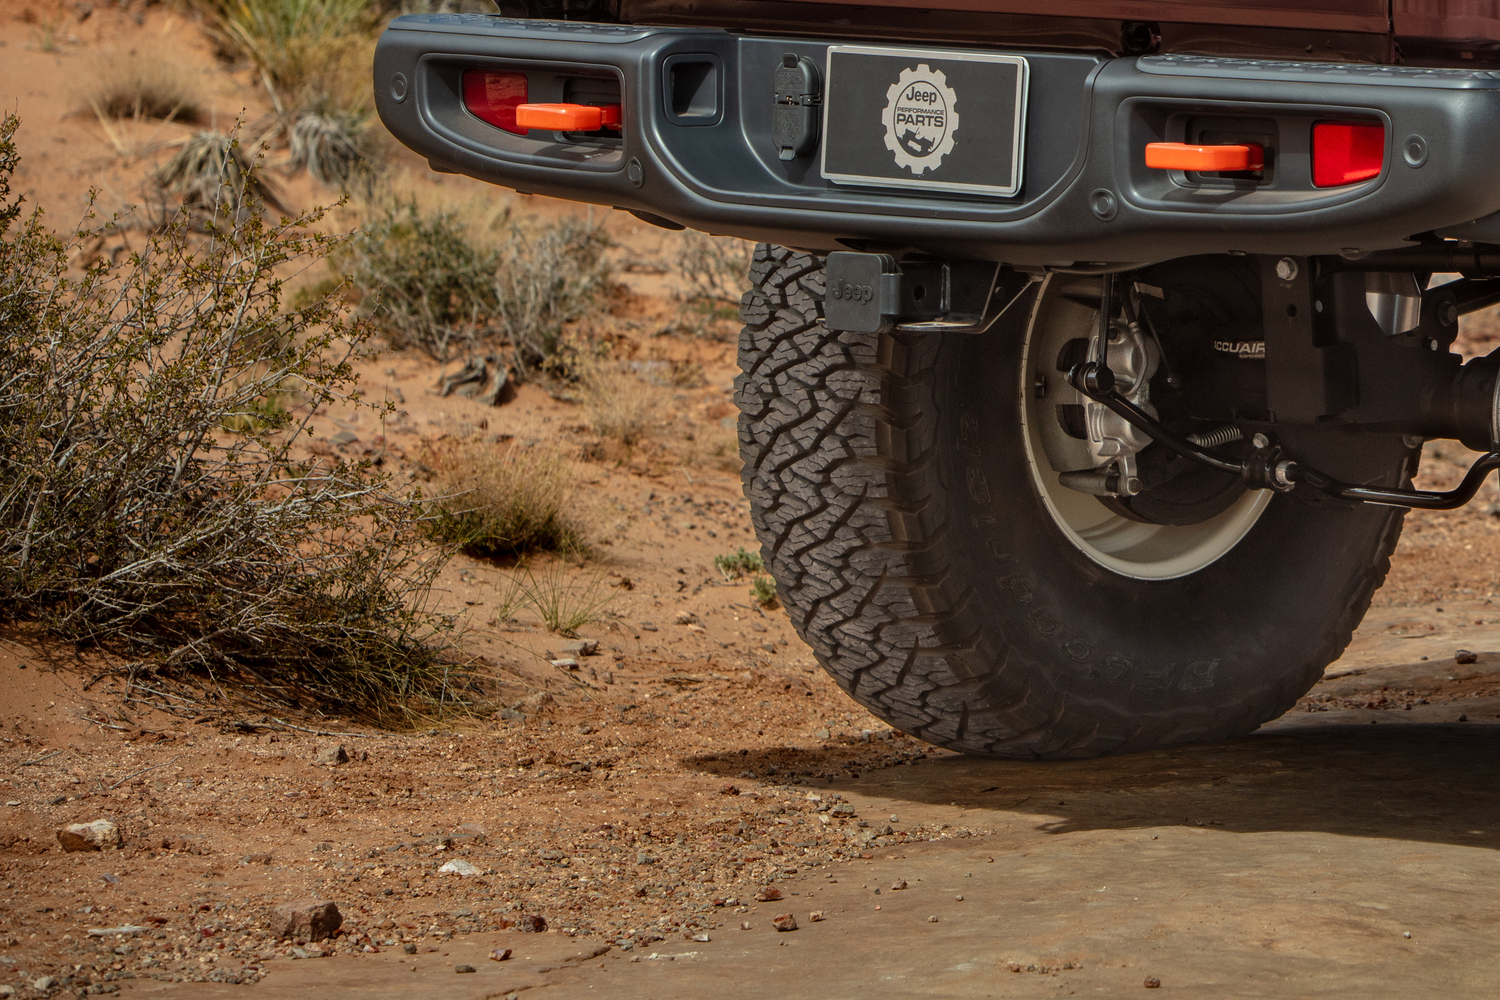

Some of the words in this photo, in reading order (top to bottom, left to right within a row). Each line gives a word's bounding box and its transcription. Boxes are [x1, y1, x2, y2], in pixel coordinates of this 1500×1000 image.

[906, 86, 937, 106] Jeep
[897, 106, 944, 116] PERFORMANCE
[896, 113, 944, 128] PARTS
[832, 278, 874, 305] Jeep
